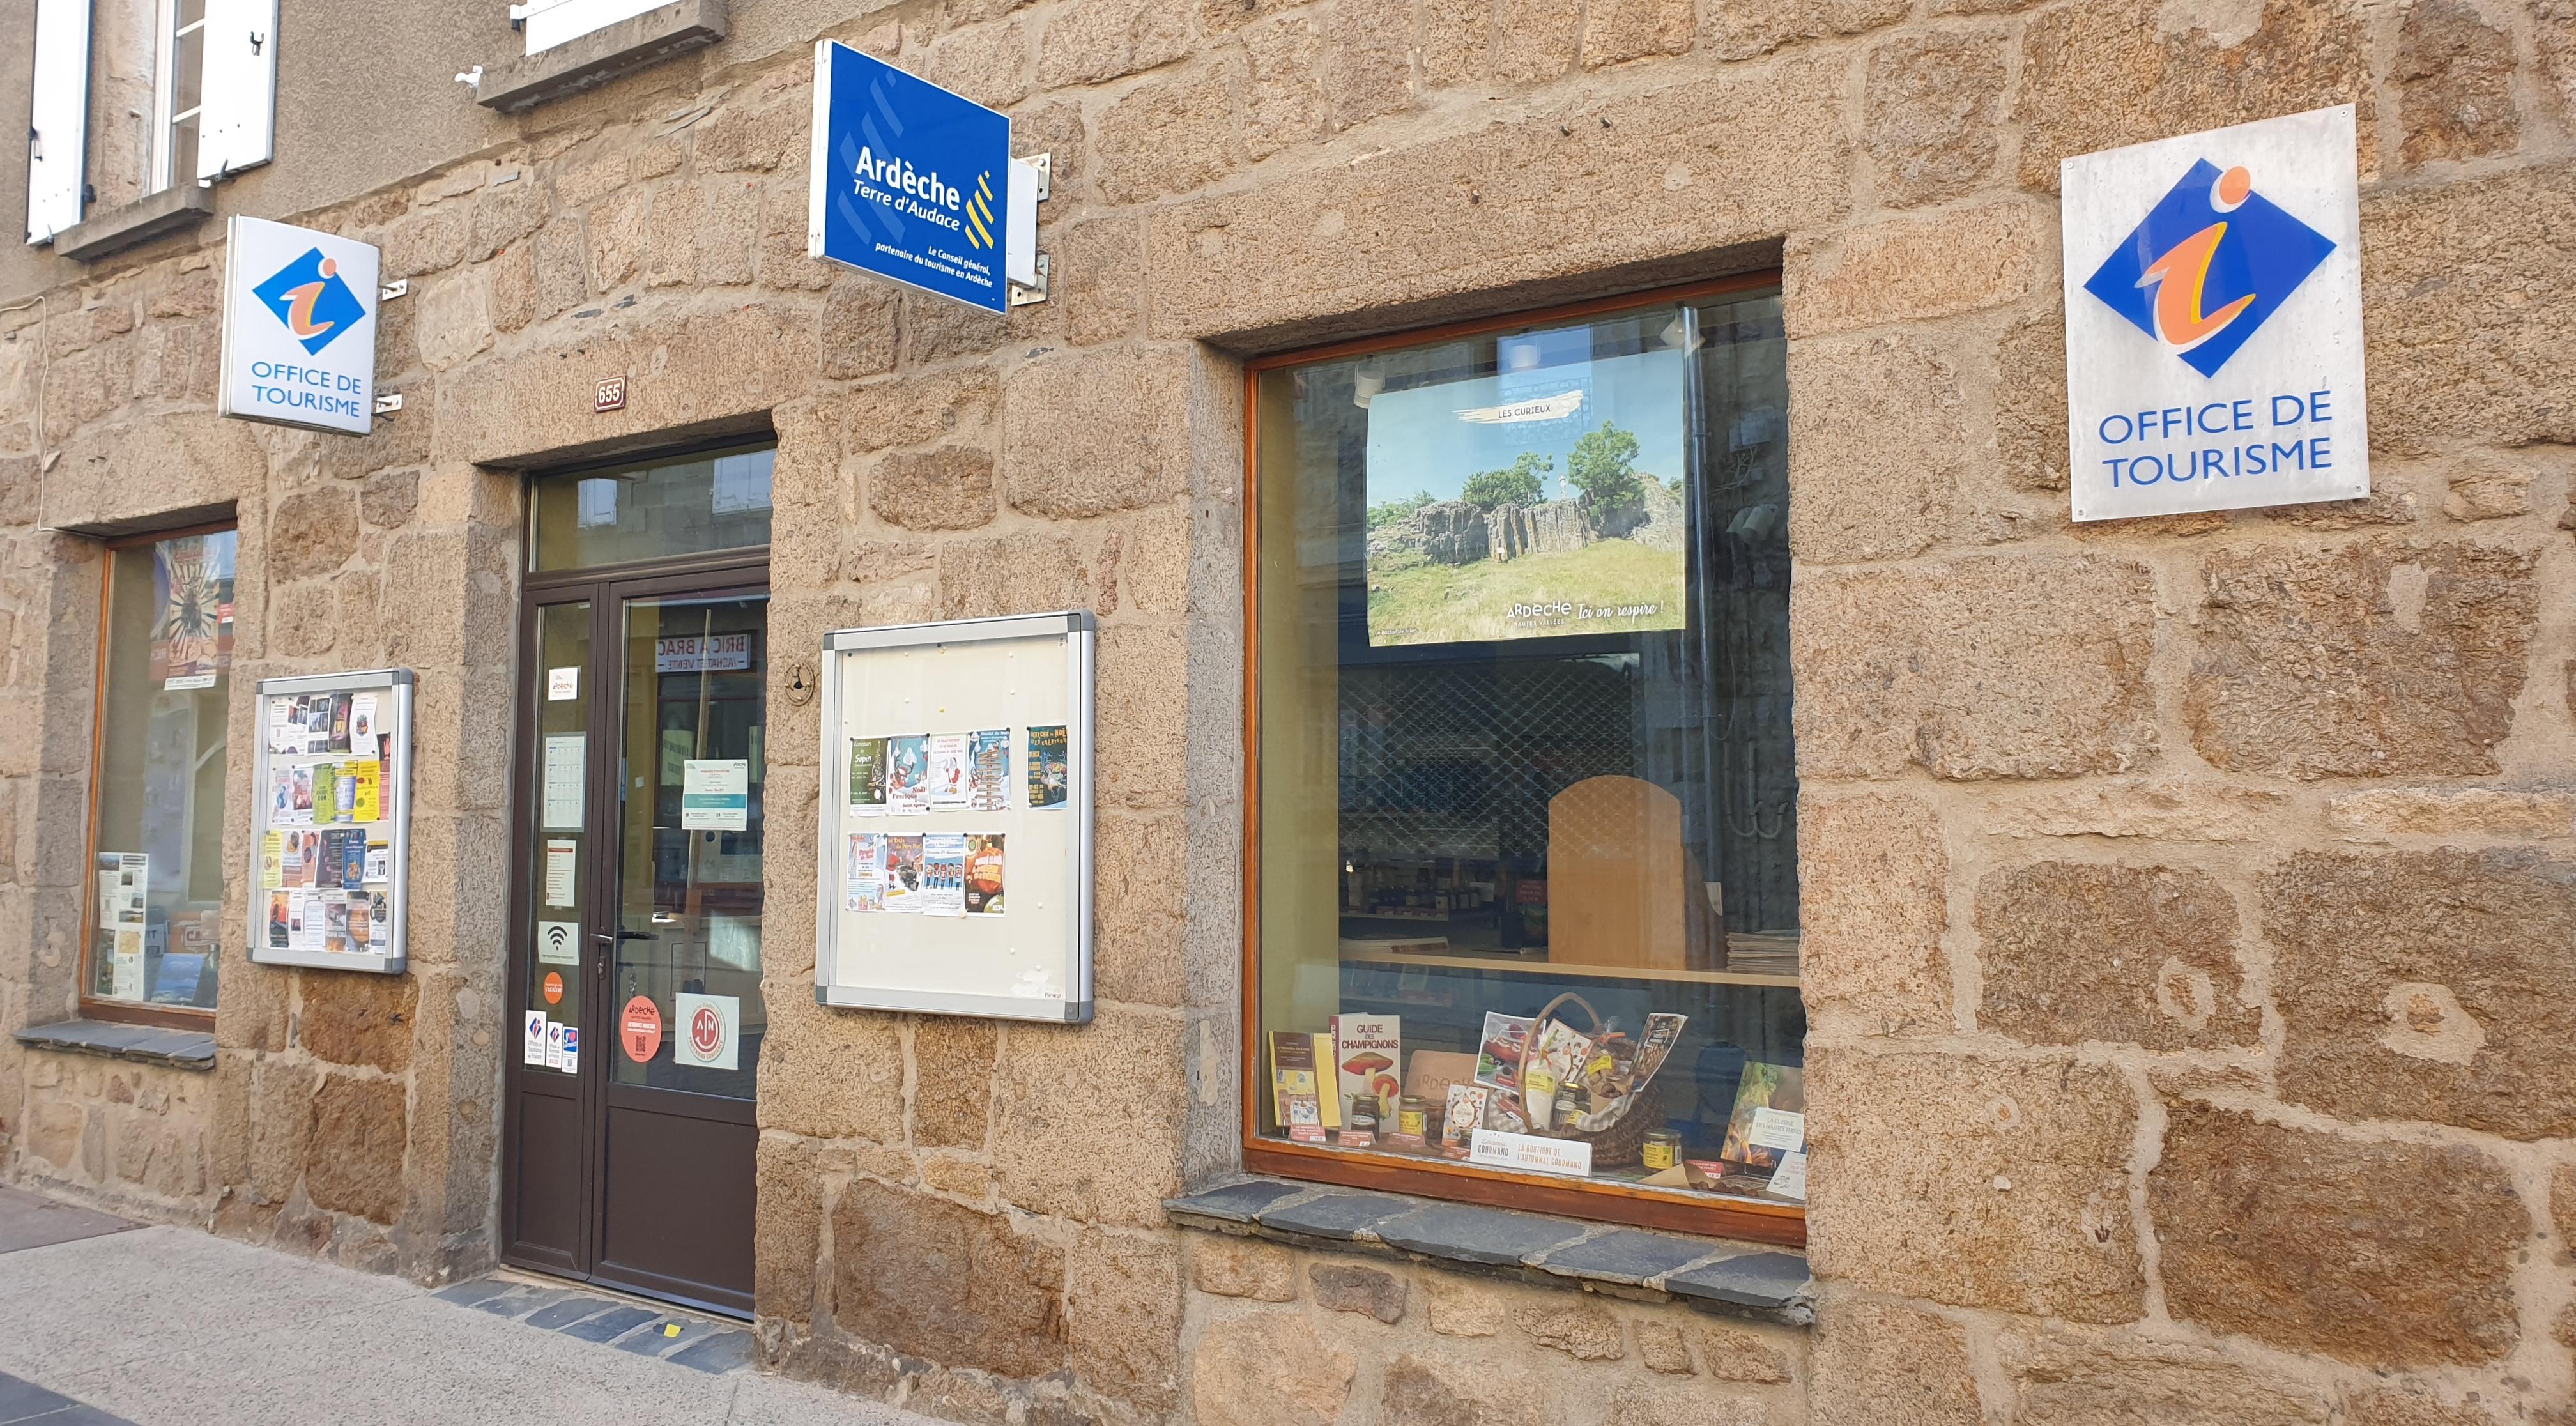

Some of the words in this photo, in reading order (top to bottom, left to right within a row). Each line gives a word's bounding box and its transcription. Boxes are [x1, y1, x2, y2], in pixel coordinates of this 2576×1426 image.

[855, 146, 960, 211] Ardèche
[854, 179, 892, 206] Terre
[894, 196, 960, 231] d'Audace
[875, 243, 913, 261] partenaire
[914, 255, 923, 264] du
[924, 258, 954, 275] tourisme
[956, 270, 964, 279] en
[965, 272, 992, 288] Ardèche
[928, 246, 937, 256] Le
[938, 250, 963, 265] Conseil
[963, 260, 991, 276] général,
[252, 362, 330, 388] OFFICE
[337, 374, 361, 394] DE
[252, 385, 360, 418] TOURISME
[599, 383, 620, 404] 655
[1498, 409, 1512, 418] LES
[1514, 404, 1551, 416] CURIEUX
[2099, 399, 2254, 445] OFFICE
[2272, 390, 2333, 427] DE
[2102, 437, 2333, 488] TOURISME
[1577, 603, 1593, 620] Ici
[1596, 607, 1614, 618] on
[1617, 602, 1657, 624] respire
[1513, 620, 1537, 628] HAUTES
[854, 754, 871, 764] Sapin
[1356, 1024, 1383, 1033] GUIDE
[1342, 1040, 1399, 1049] CHAMPIGNONS
[1478, 1144, 1509, 1157] GOURMAND
[1517, 1144, 1524, 1152] LA
[1526, 1145, 1551, 1156] BOUTIQUE
[1553, 1148, 1560, 1156] DE
[1551, 1158, 1582, 1170] GOURMAND
